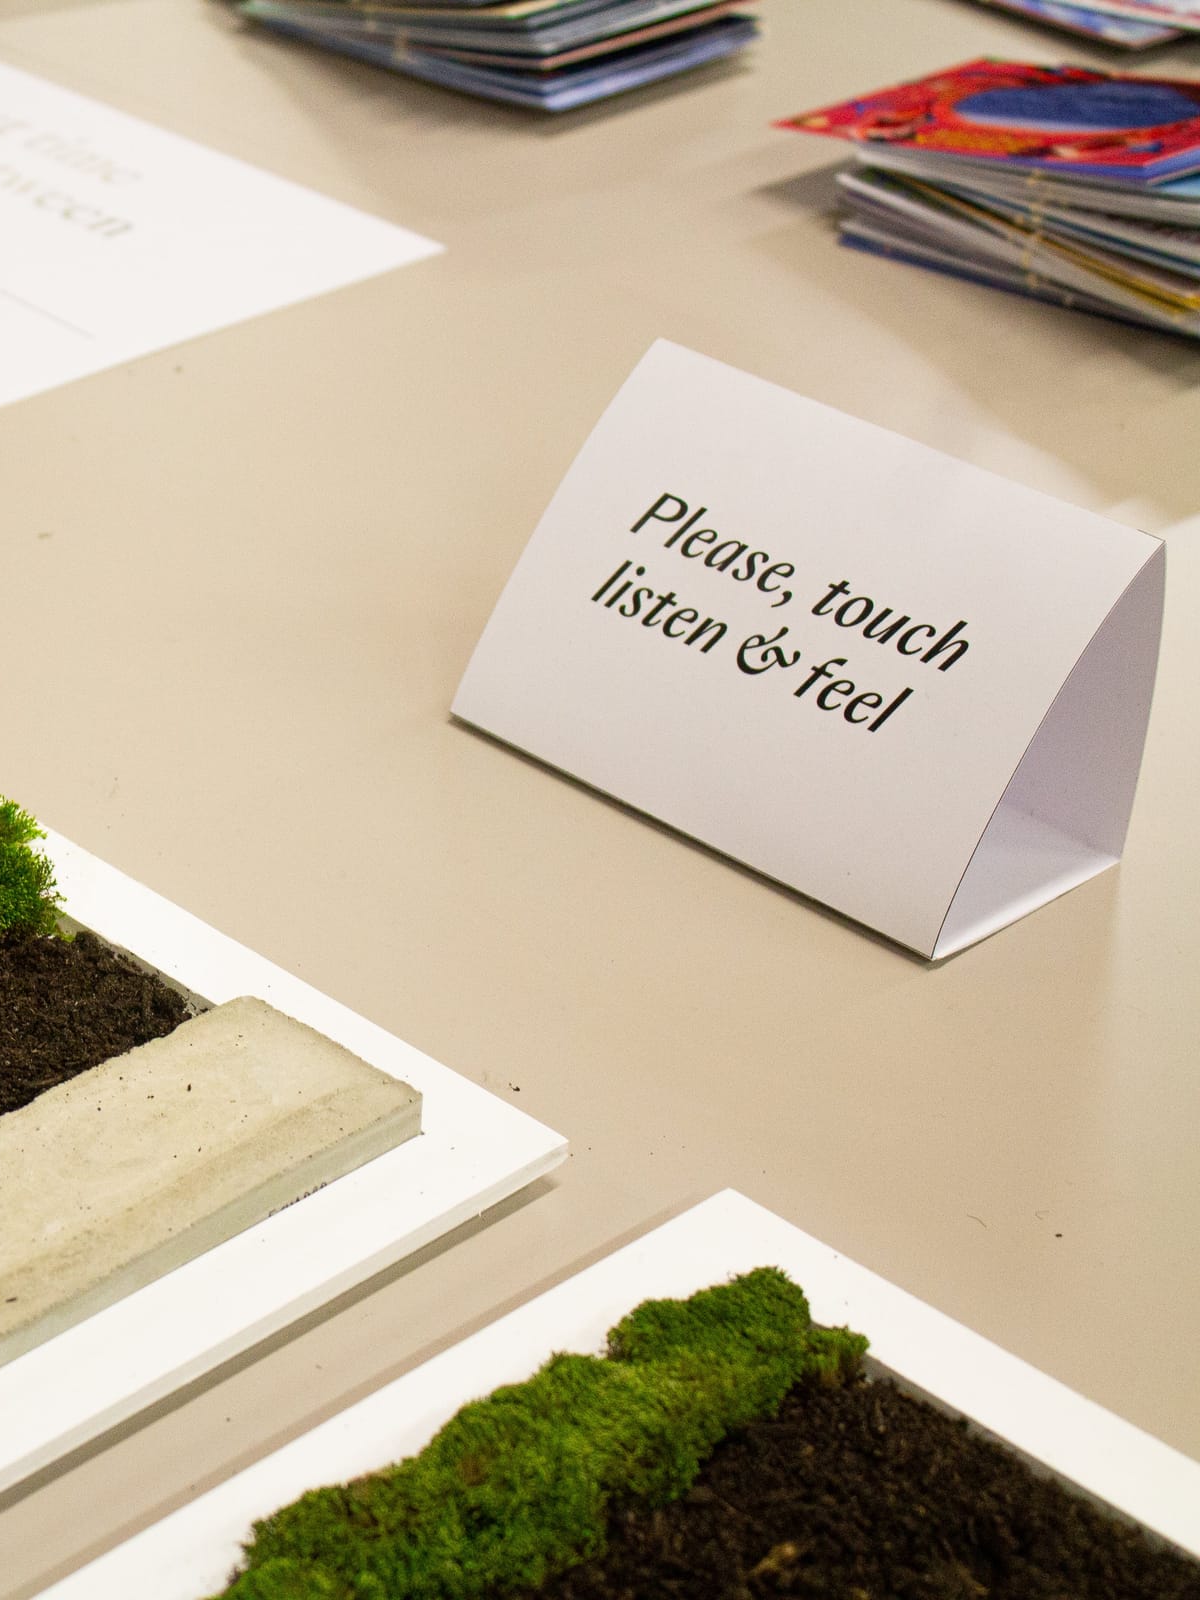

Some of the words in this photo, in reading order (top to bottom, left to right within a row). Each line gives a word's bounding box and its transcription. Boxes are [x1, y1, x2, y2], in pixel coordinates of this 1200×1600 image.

[591, 560, 728, 654] listen
[736, 627, 800, 675] &
[794, 658, 914, 732] feel
[630, 493, 795, 608] Please,
[811, 579, 969, 672] touch
